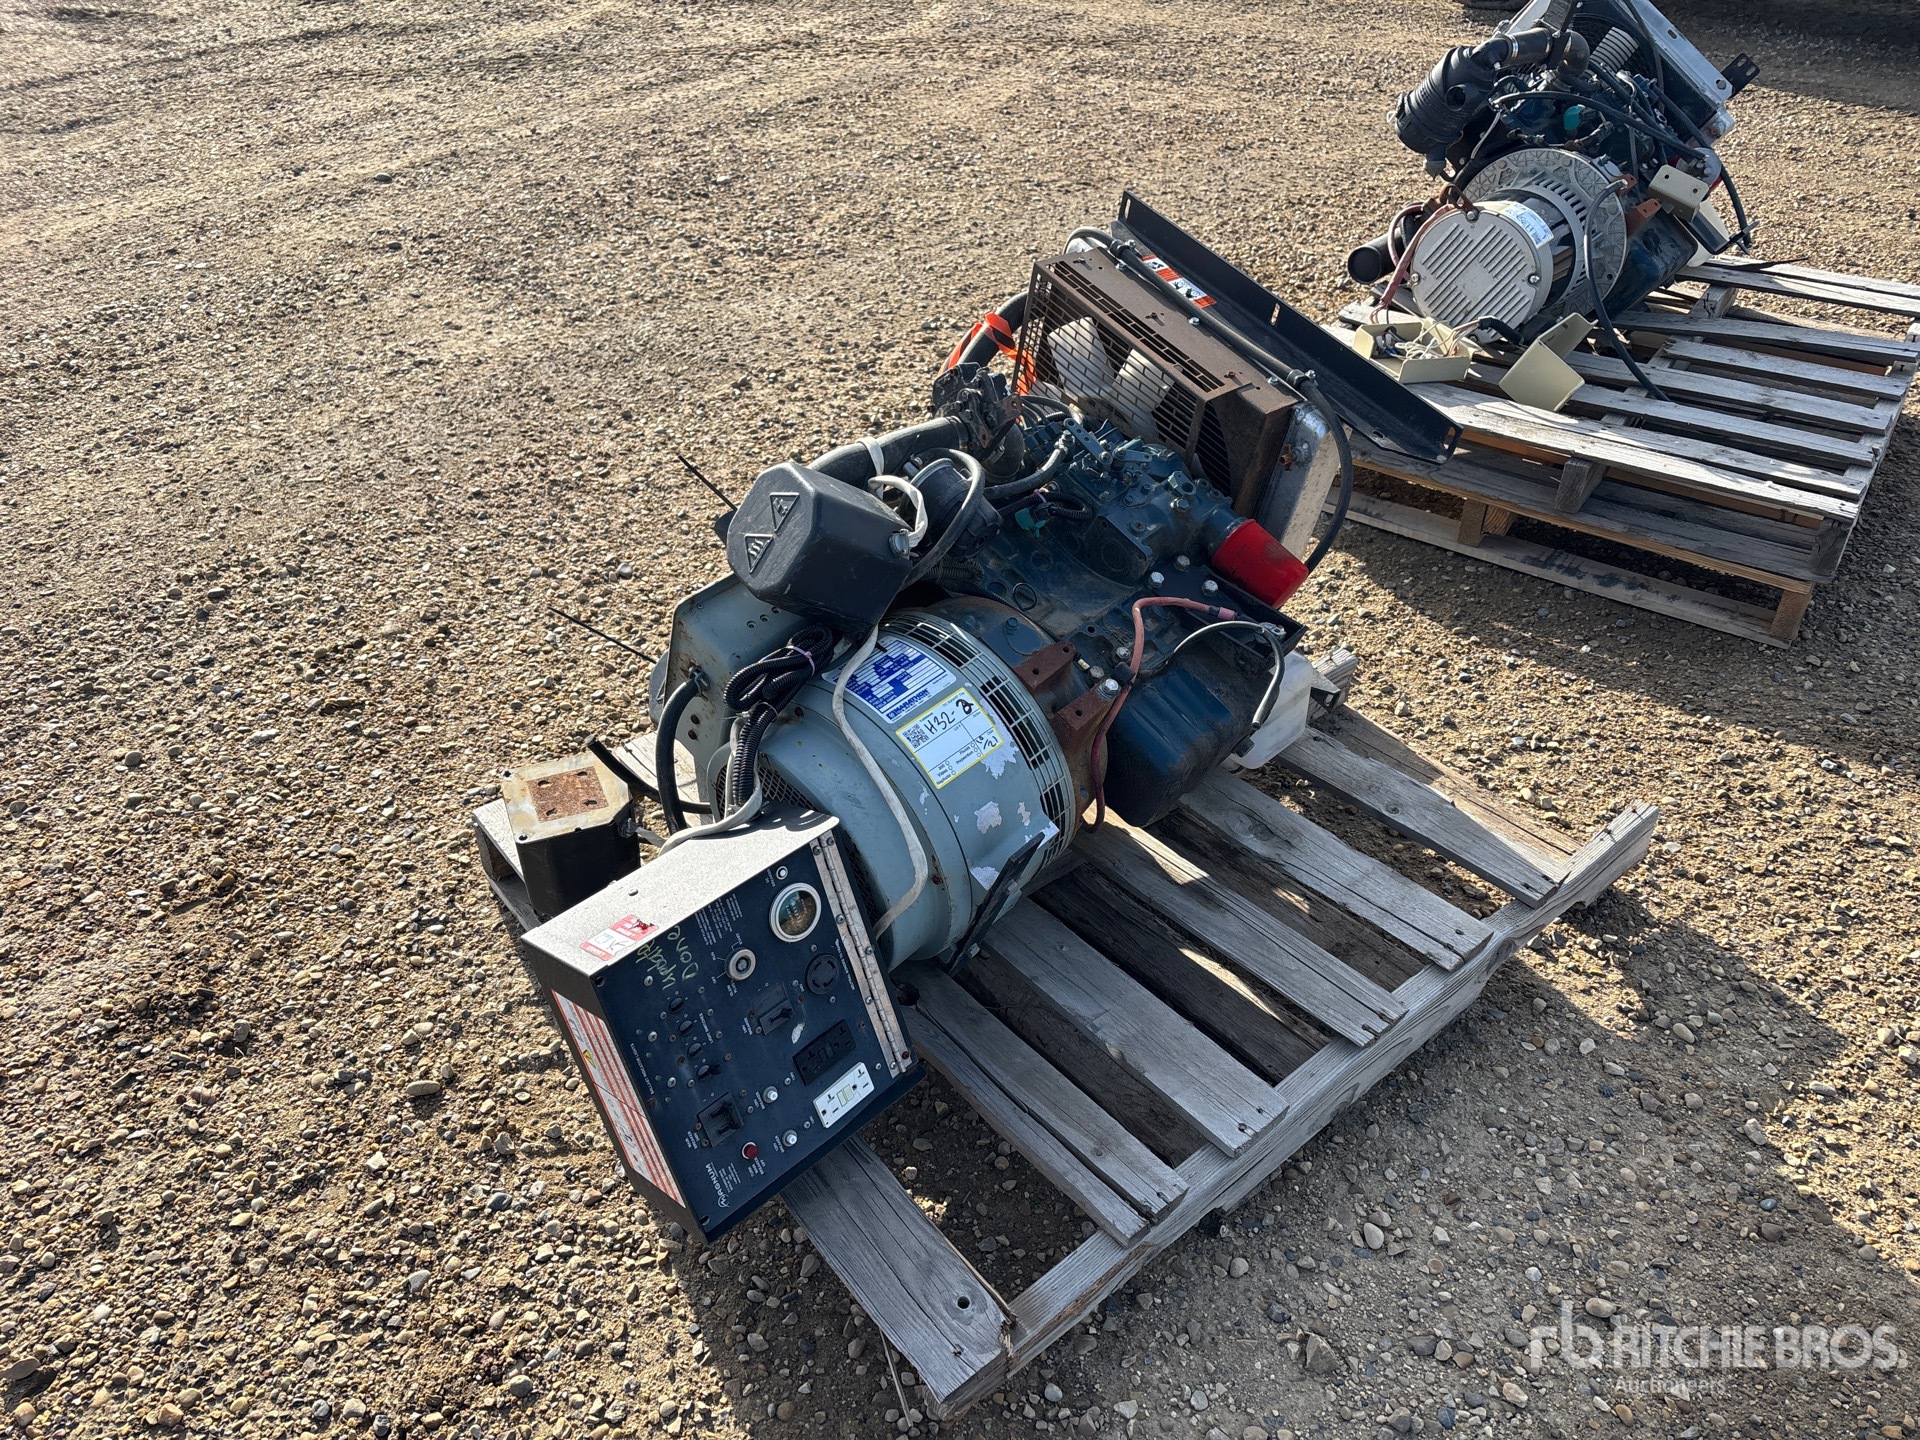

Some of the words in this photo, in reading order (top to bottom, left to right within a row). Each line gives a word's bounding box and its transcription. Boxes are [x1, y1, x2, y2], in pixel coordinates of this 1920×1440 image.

[936, 767, 948, 777] Video
[955, 750, 974, 764] Inspection
[666, 925, 699, 980] Done
[704, 1162, 730, 1208] MAGNUM
